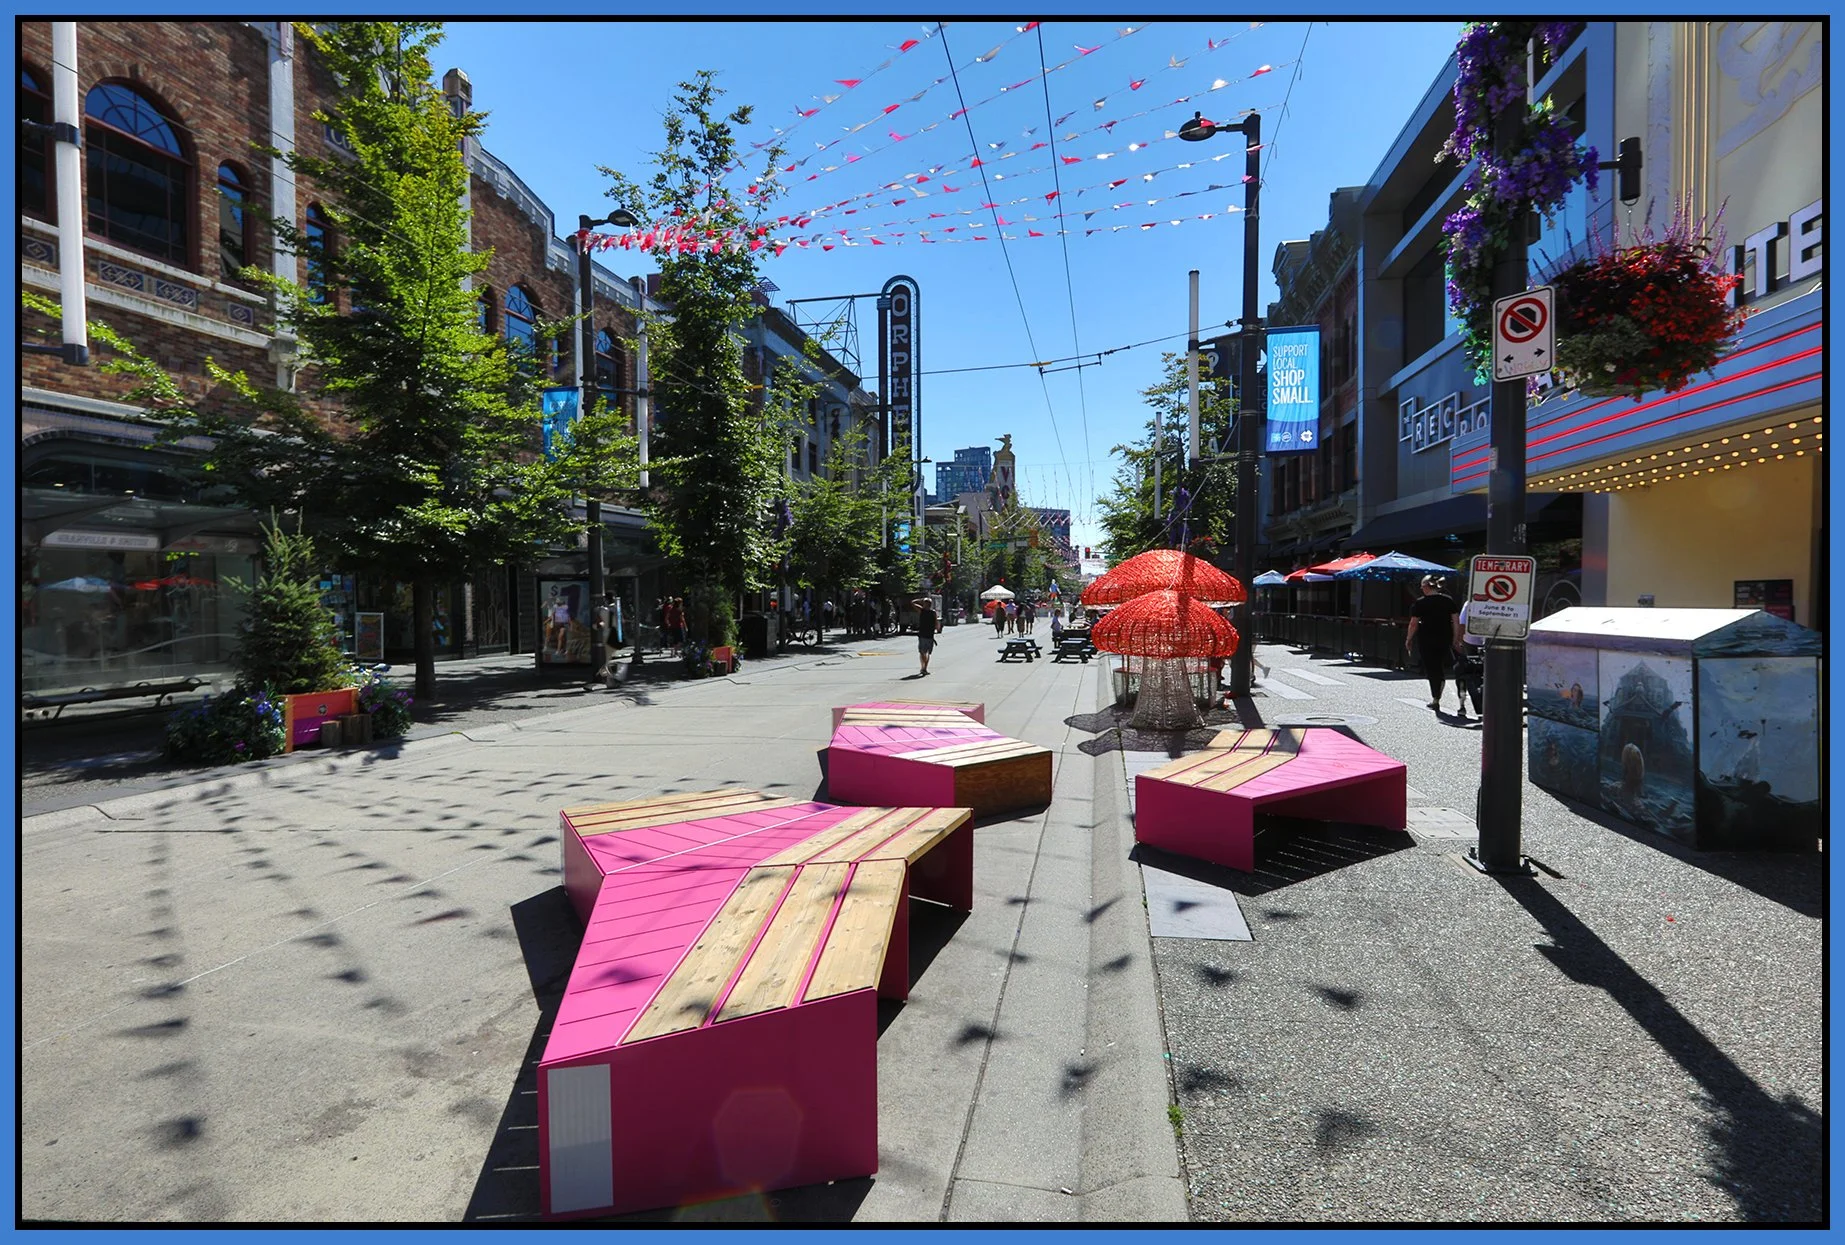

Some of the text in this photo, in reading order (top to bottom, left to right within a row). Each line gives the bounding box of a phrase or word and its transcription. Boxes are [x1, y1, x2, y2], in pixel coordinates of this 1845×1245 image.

[1272, 344, 1309, 357] SUPPORT
[892, 293, 909, 463] ORPHE
[1272, 369, 1305, 387] SHOP
[1272, 386, 1314, 405] SMALL.
[1416, 406, 1452, 442] REC
[1460, 411, 1487, 437] RO
[1477, 560, 1529, 572] TEMPORARY
[1479, 610, 1511, 618] September
